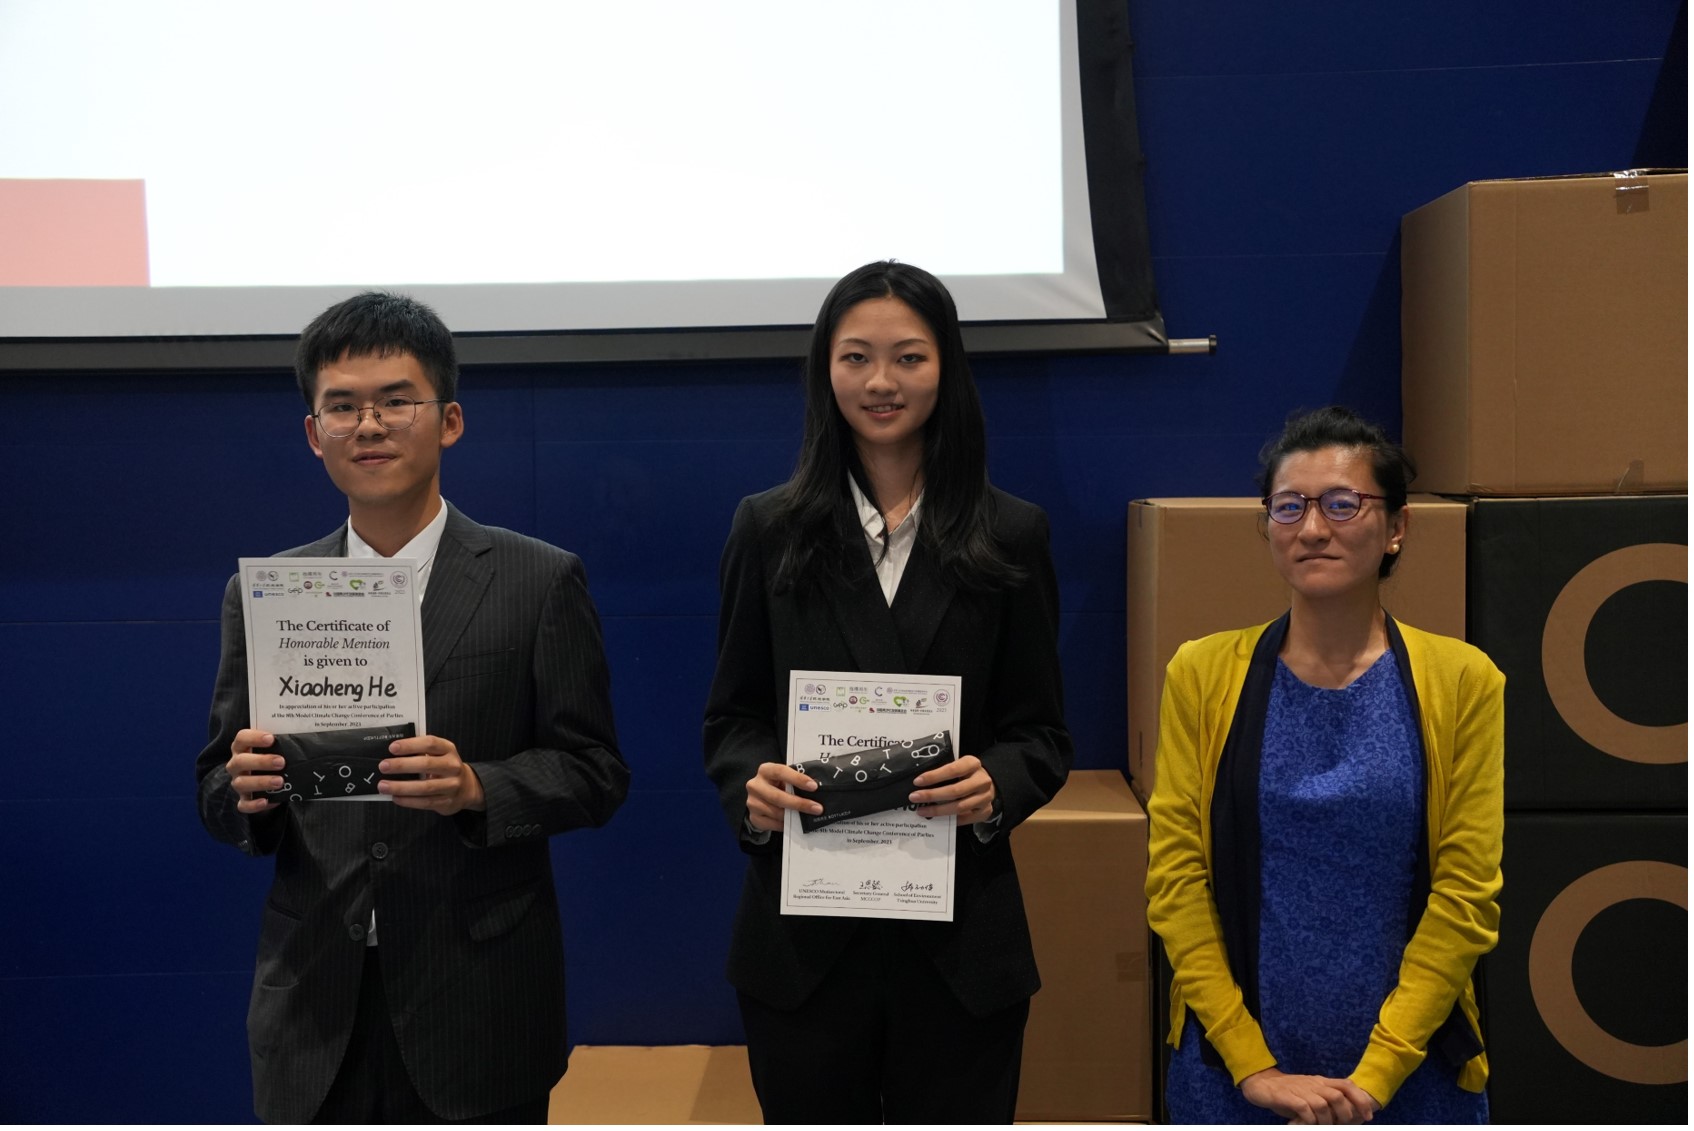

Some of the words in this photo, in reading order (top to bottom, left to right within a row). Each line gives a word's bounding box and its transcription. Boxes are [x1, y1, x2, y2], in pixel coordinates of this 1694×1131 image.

[276, 620, 303, 631] The
[306, 620, 373, 631] Certificate
[377, 620, 391, 631] of
[279, 637, 339, 649] Honorable
[342, 638, 389, 649] Mention
[304, 655, 314, 666] is
[317, 655, 352, 669] given
[355, 657, 367, 666] to
[279, 676, 363, 702] Xiaoheng
[368, 676, 397, 697] He
[817, 734, 848, 747] The
